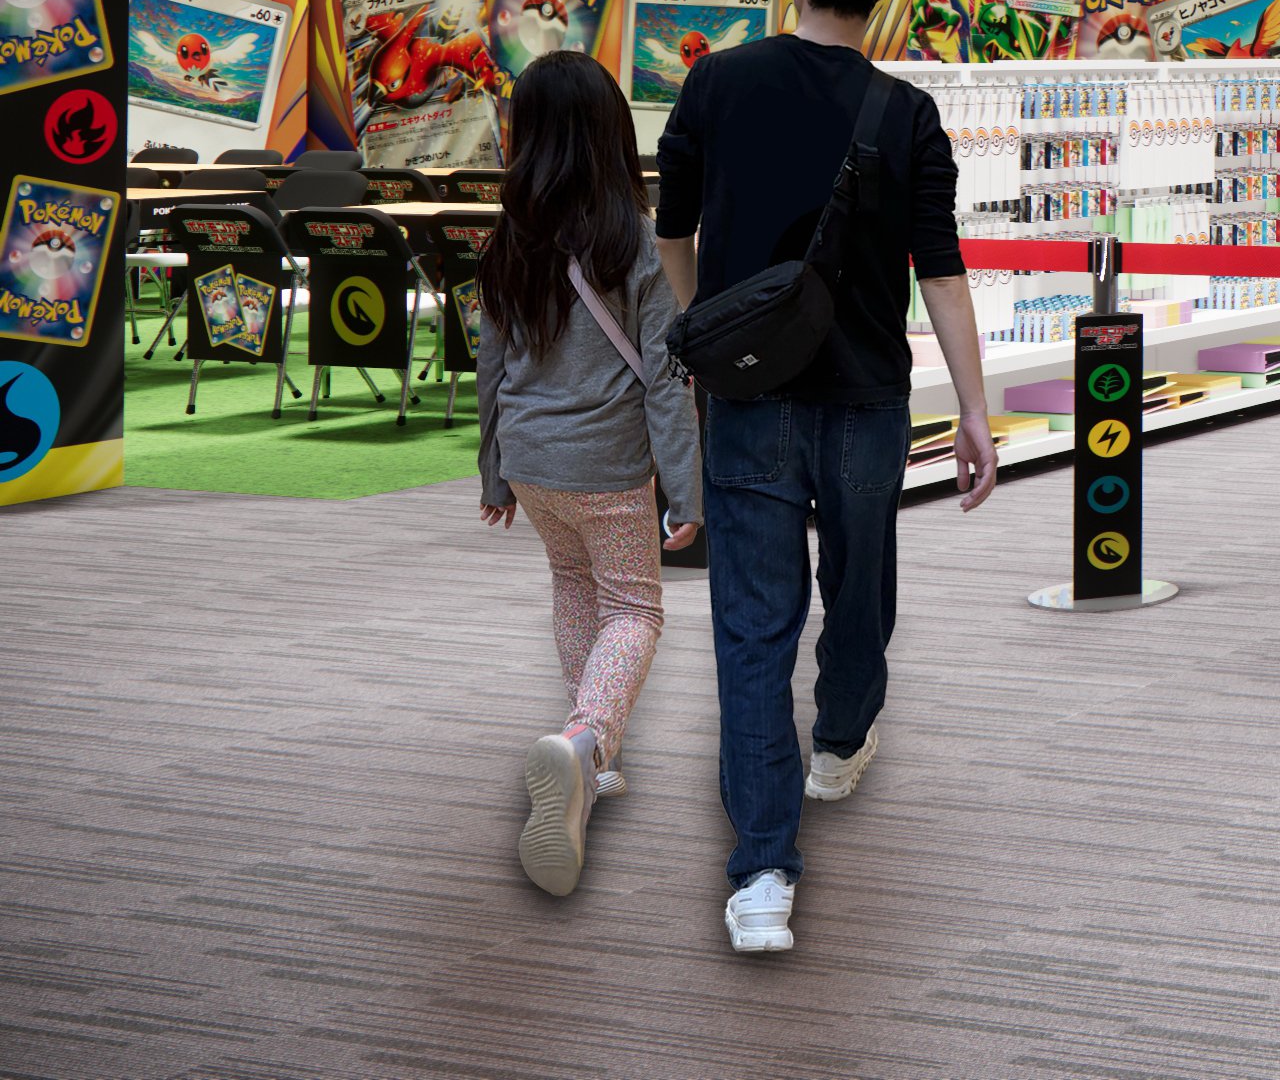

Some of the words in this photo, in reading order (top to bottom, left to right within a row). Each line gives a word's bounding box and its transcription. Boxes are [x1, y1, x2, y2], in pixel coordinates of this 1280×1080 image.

[256, 9, 271, 21] 60
[184, 220, 250, 234] ポケモンカード
[304, 222, 375, 237] ポケモンカード
